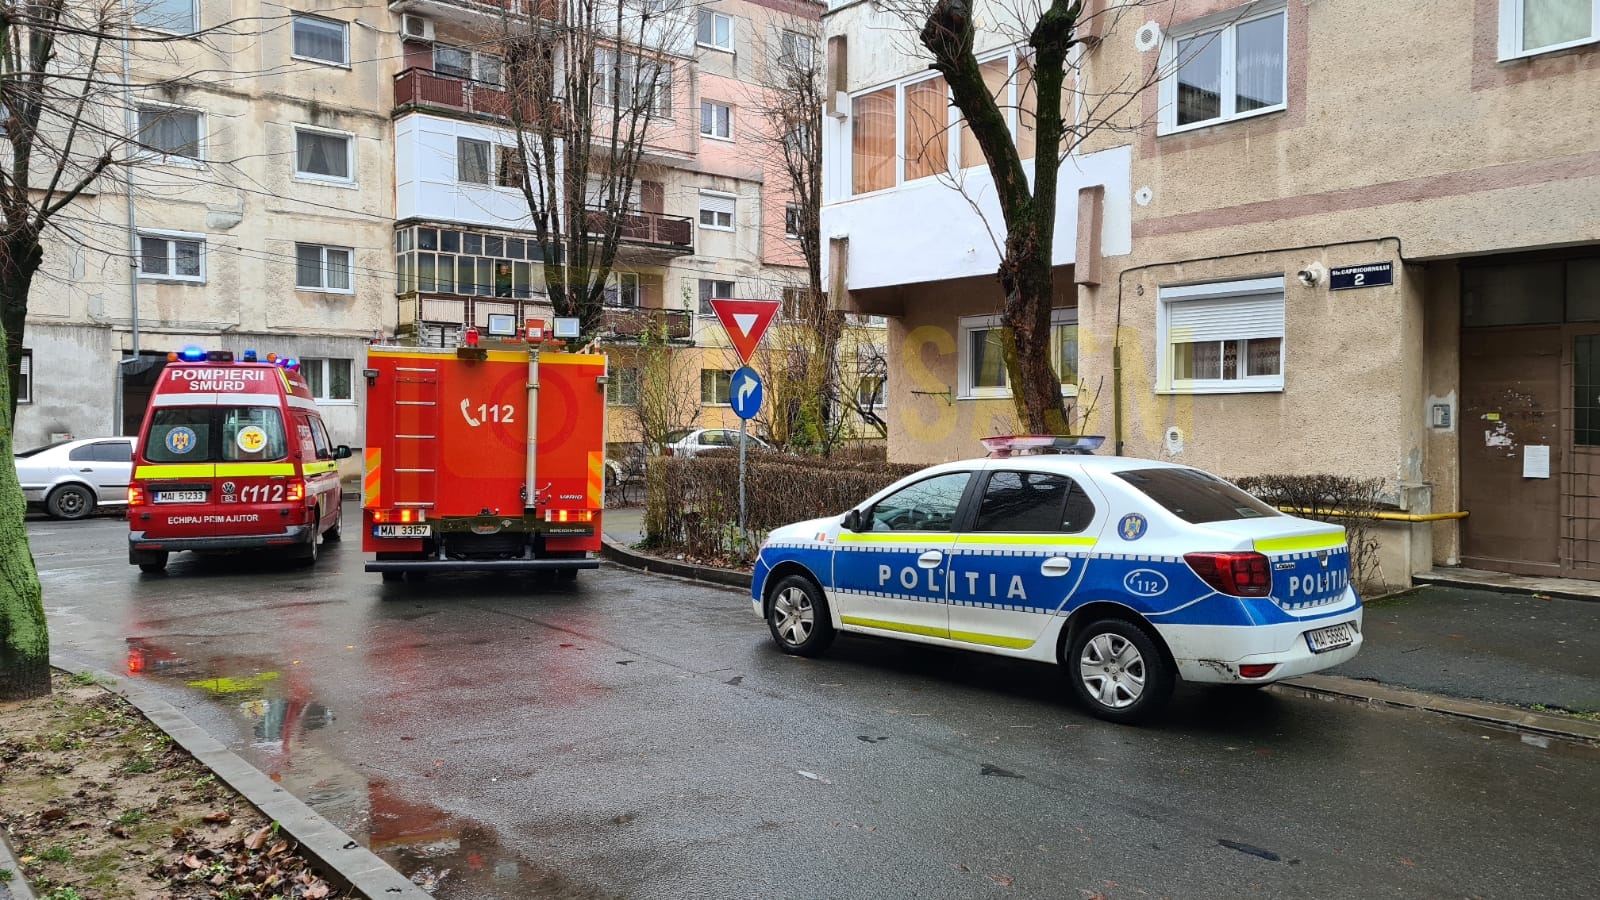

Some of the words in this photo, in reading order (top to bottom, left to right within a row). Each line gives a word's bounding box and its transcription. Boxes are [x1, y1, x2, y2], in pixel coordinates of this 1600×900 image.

[1354, 273, 1365, 286] 2
[171, 369, 264, 381] POMPIERII
[189, 380, 245, 391] SMURD
[477, 403, 515, 423] 112
[160, 492, 175, 501] MAI
[178, 491, 204, 500] 51233
[250, 484, 284, 503] 112
[167, 516, 202, 525] ECHIPAJ
[225, 514, 259, 522] AJUTOR
[380, 525, 396, 535] MAI
[401, 524, 428, 535] 33157
[878, 564, 1027, 600] POLITIA
[1137, 580, 1158, 592] 112
[1289, 567, 1348, 597] POLITIA
